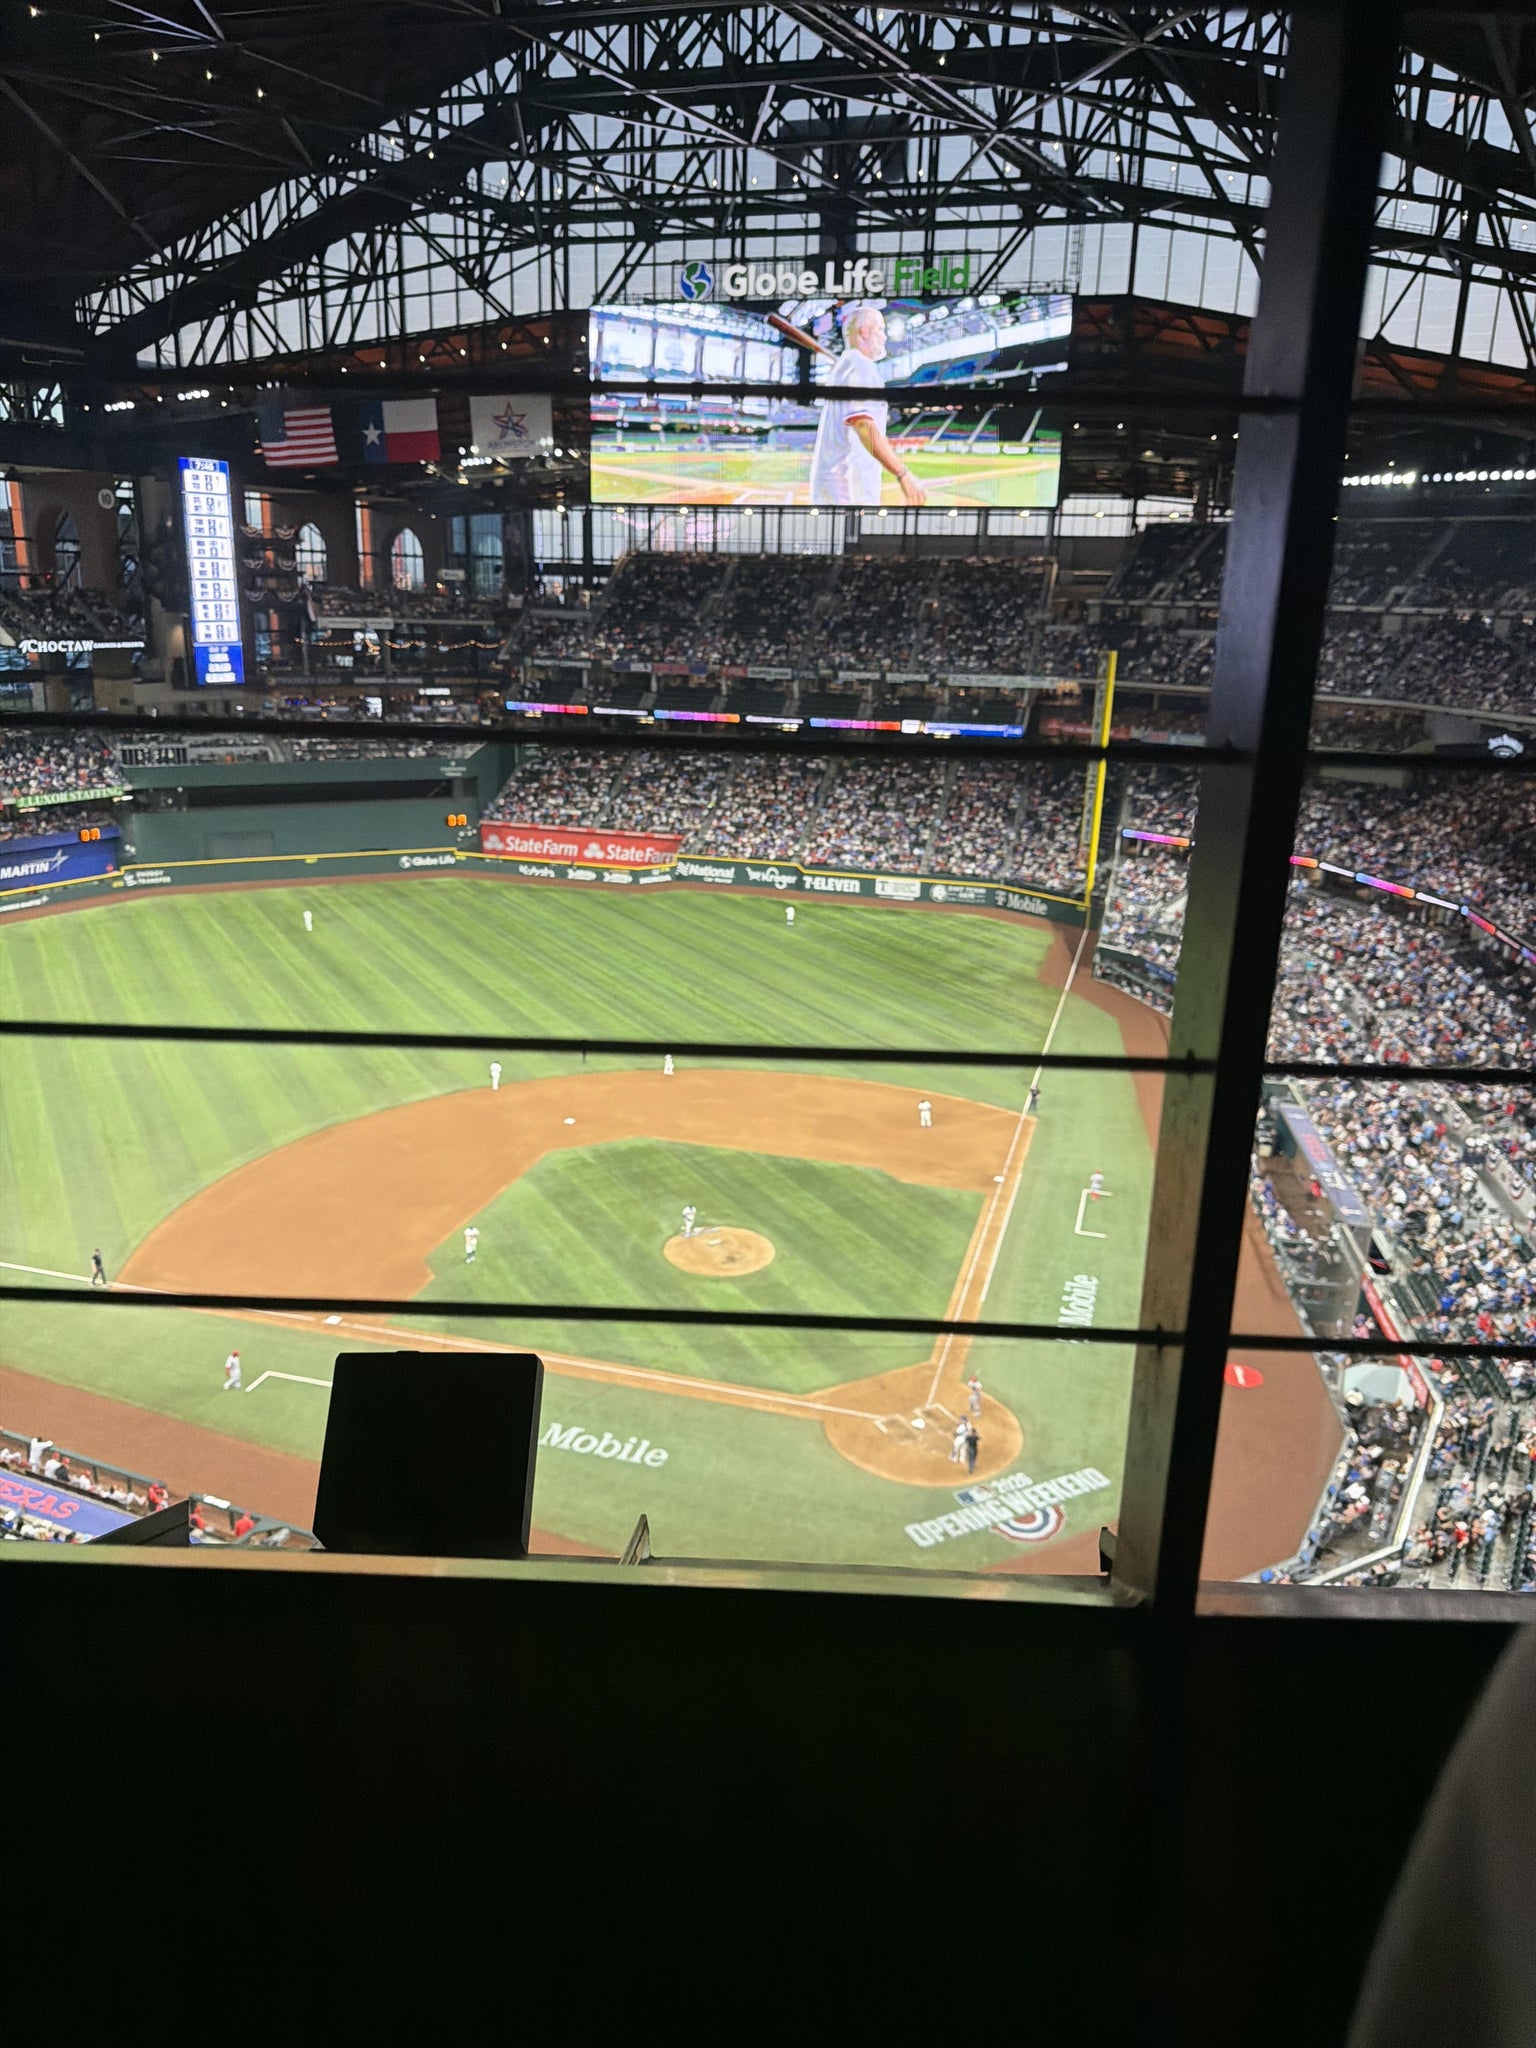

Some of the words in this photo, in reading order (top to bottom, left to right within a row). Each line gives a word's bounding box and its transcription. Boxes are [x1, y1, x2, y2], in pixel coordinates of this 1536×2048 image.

[722, 263, 820, 297] Globe
[825, 258, 885, 294] Life
[893, 256, 970, 292] Field
[28, 639, 94, 652] CHOCTAW
[68, 786, 121, 802] STAFFING
[0, 862, 49, 879] MARTIN
[690, 865, 736, 878] National
[1008, 892, 1048, 915] Mobile
[537, 1422, 669, 1467] Mobile
[0, 1478, 80, 1519] EXAS
[904, 1499, 1016, 1548] OPENING
[999, 1467, 1112, 1516] WEEKEND
